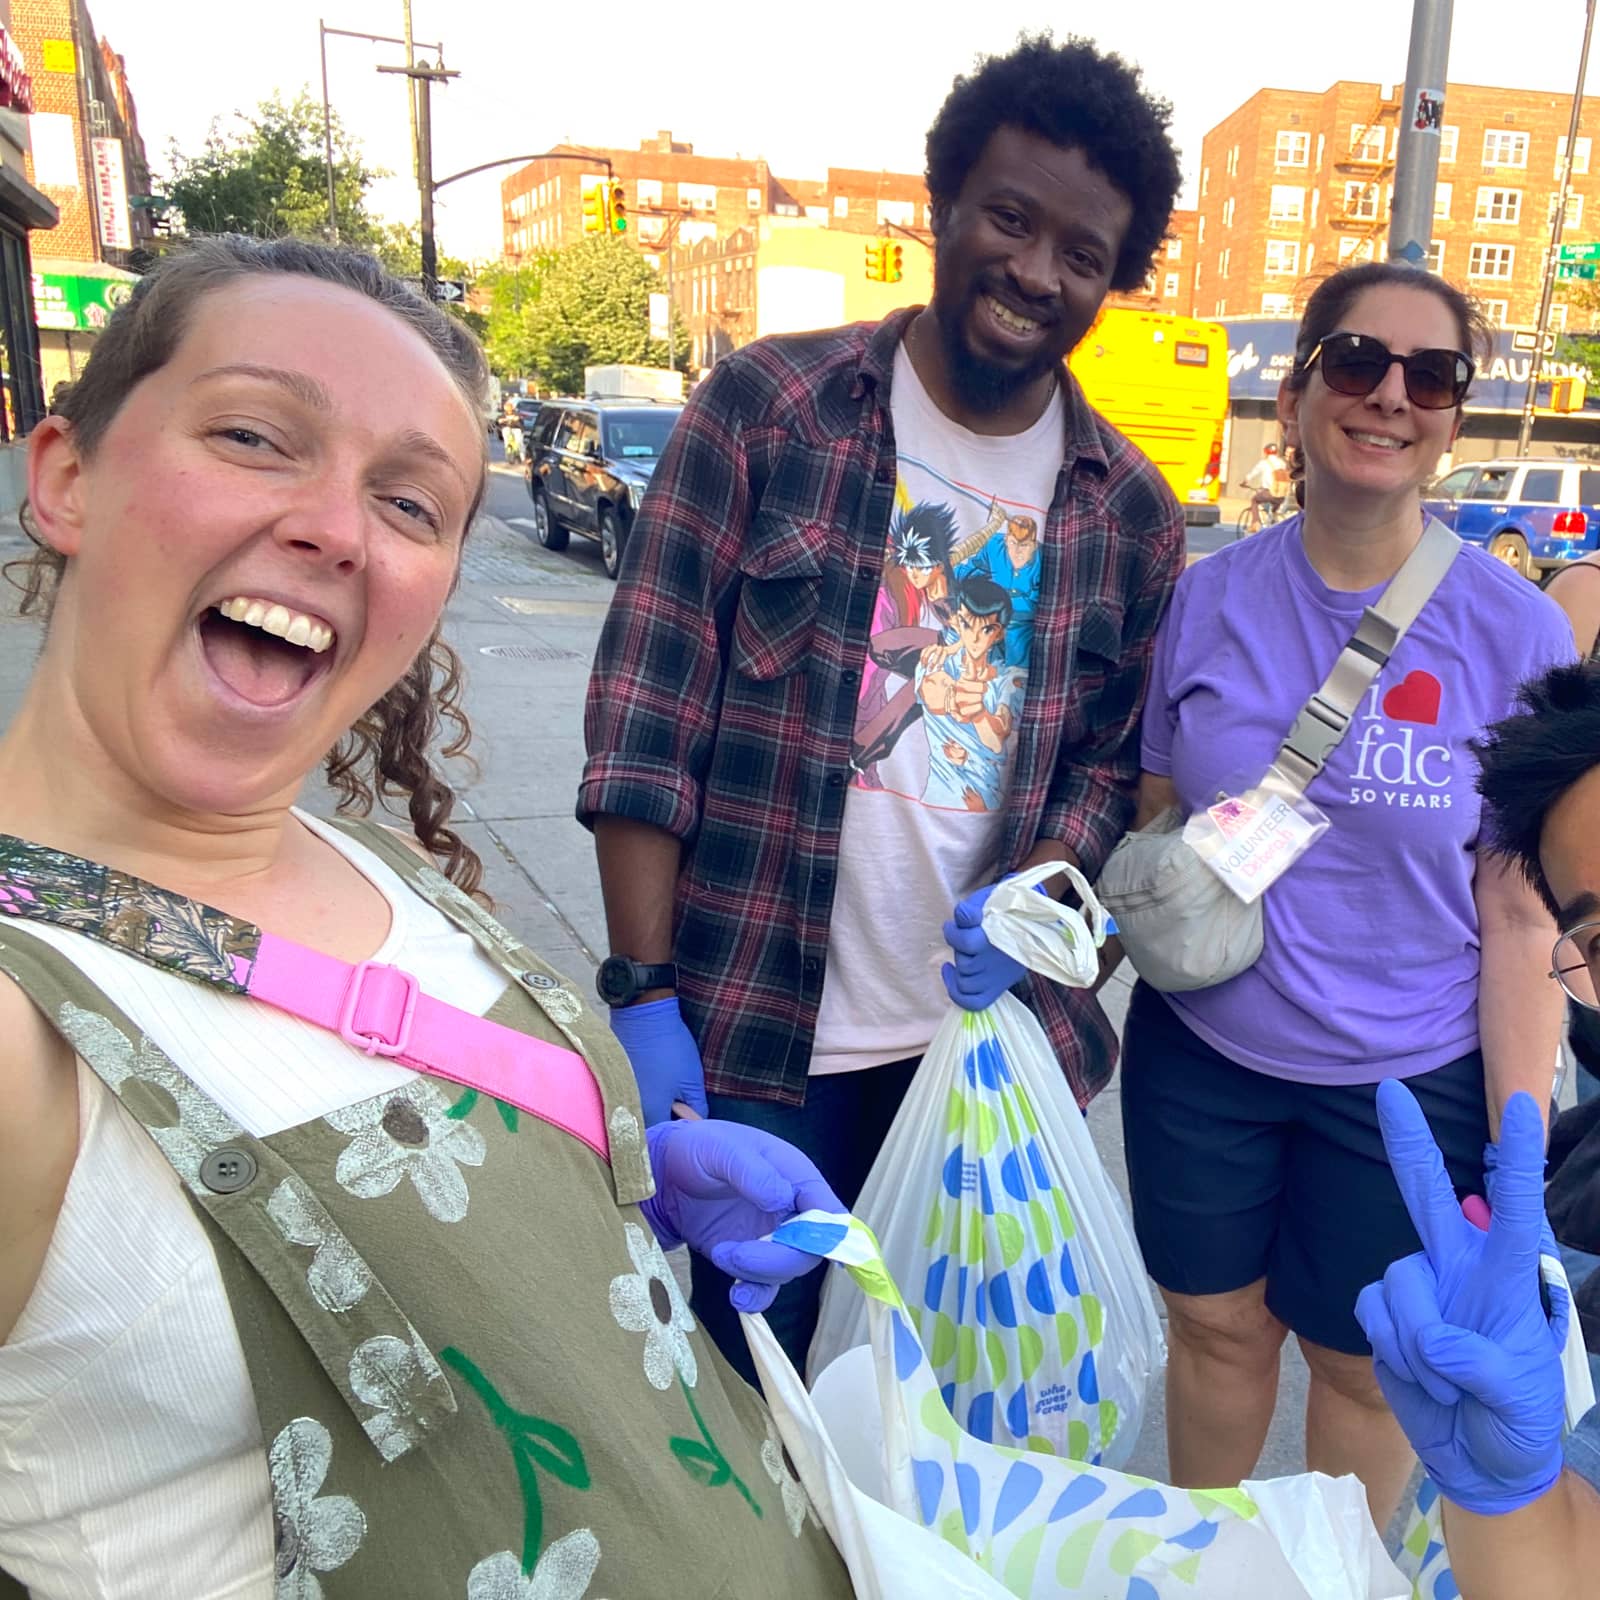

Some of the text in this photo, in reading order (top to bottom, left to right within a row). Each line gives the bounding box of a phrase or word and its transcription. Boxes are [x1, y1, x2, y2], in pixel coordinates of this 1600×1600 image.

[1362, 671, 1382, 721] i
[1350, 724, 1451, 788] fdc
[1350, 788, 1452, 809] 50 YEARS
[1218, 802, 1292, 875] VOLUNTEER
[1041, 1402, 1069, 1415] crap
